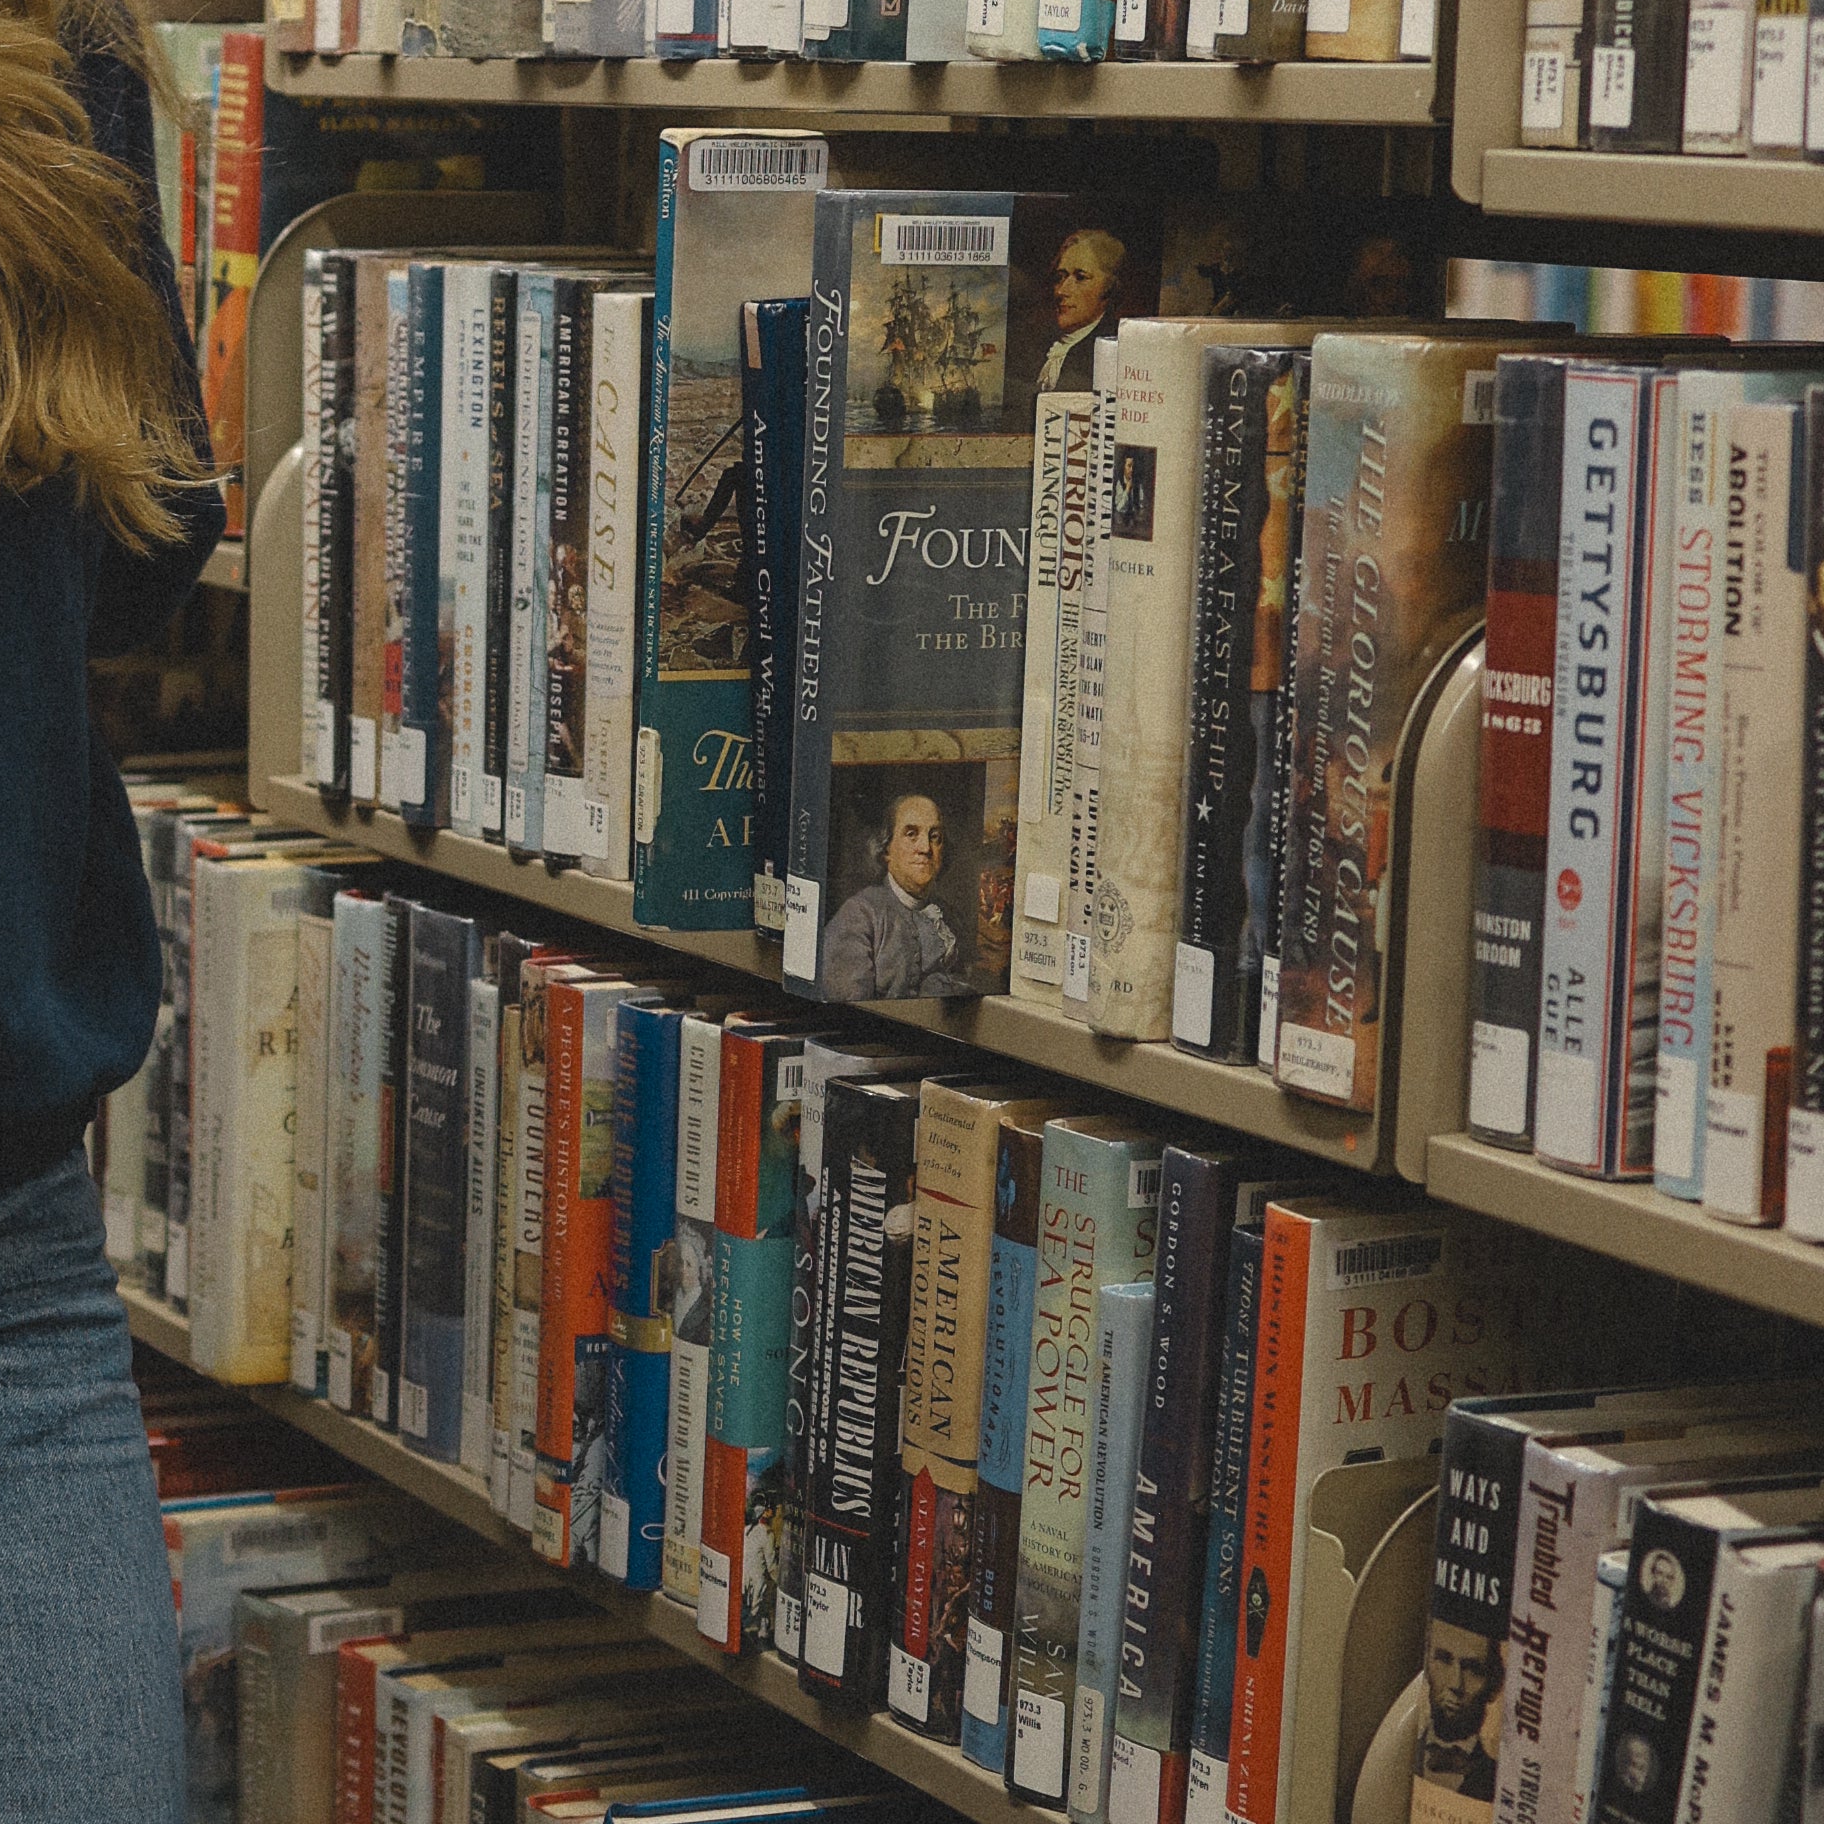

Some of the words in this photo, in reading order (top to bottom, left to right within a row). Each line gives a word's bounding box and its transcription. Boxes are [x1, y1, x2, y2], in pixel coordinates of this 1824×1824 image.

[1042, 4, 1073, 19] TAYLOR
[705, 173, 808, 187] 31111006806465
[899, 251, 906, 261] 3
[909, 252, 931, 262] 1111
[934, 252, 965, 262] 03613
[966, 252, 992, 262] 1868
[469, 307, 486, 430] LEXINGTON
[556, 314, 572, 417] AMERICAN
[806, 280, 847, 519] FOUNDING
[1223, 367, 1249, 473] GIVE
[552, 425, 571, 522] CREATION
[592, 379, 620, 593] CAUSE
[1062, 411, 1094, 593] PATRIOTS
[1219, 478, 1242, 544] ME
[1355, 419, 1390, 533] THE
[1217, 552, 1237, 575] A
[799, 523, 834, 726] FATHERS
[1213, 589, 1236, 688] FAST
[1569, 418, 1619, 842] GETTYSBURG
[1669, 526, 1714, 765] STORMING
[1205, 698, 1230, 792] SHIP
[1334, 556, 1382, 843] GLORIOUS
[1323, 858, 1365, 1035] CAUSE
[1662, 789, 1704, 1046] VICKSBURG
[555, 1024, 573, 1133] PEOPLE'S
[683, 1043, 706, 1110] COKIE
[521, 1083, 550, 1247] FOUNDERS
[552, 1138, 573, 1245] HISTORY
[681, 1114, 705, 1209] ROBERTS
[1053, 1164, 1090, 1196] THE
[844, 1156, 889, 1321] AMERICAN
[1041, 1201, 1069, 1290] SEA
[729, 1297, 744, 1341] HOW
[784, 1244, 814, 1437] SONG
[905, 1214, 935, 1426] REVOLUTIONS
[926, 1219, 964, 1442] AMERICAN
[1058, 1215, 1095, 1413] STRUGGLE
[1236, 1260, 1255, 1339] THOSE
[728, 1341, 742, 1387] THE
[1026, 1310, 1063, 1491] POWER
[830, 1330, 879, 1518] REPUBLICS
[1060, 1425, 1088, 1501] FOR
[1222, 1345, 1252, 1522] TURBULENT
[1449, 1468, 1502, 1512] WAYS
[1449, 1517, 1490, 1556] AND
[1118, 1472, 1158, 1699] AMERICA
[1217, 1530, 1238, 1597] SONS
[1435, 1557, 1501, 1607] MEANS
[1016, 1699, 1044, 1717] 973.3
[1016, 1715, 1043, 1732] Willis
[1188, 1773, 1210, 1791] Wren
